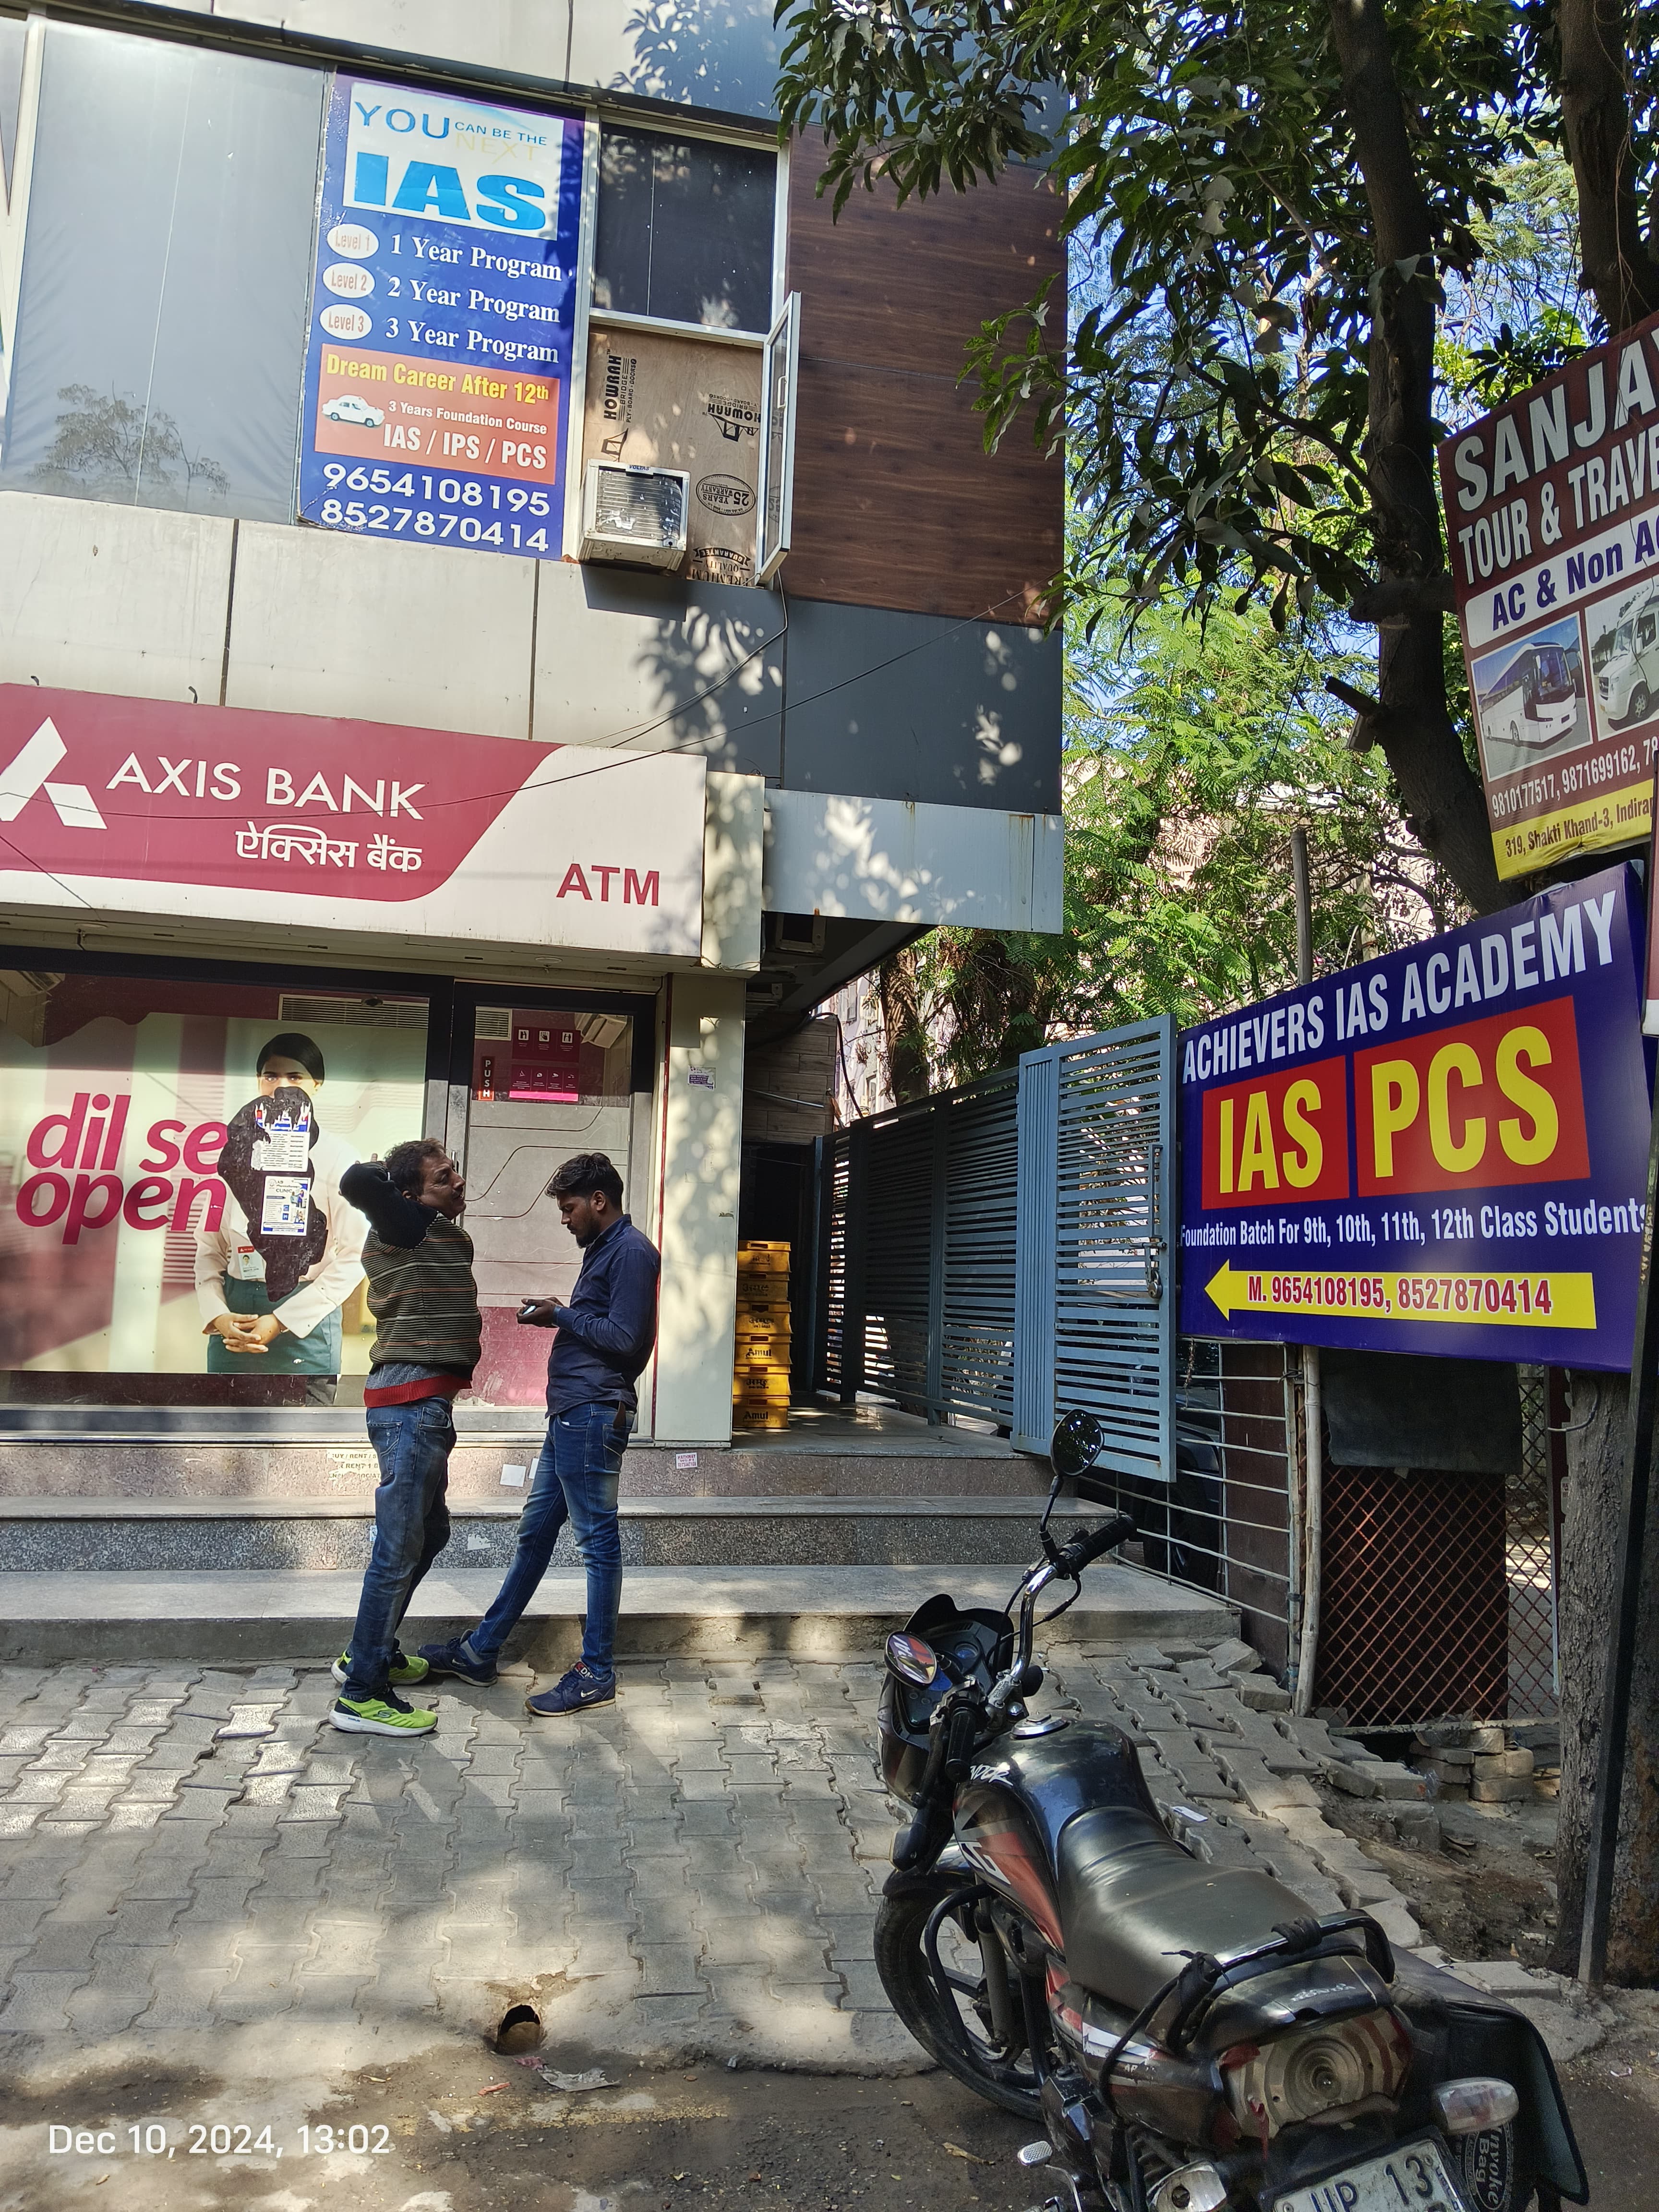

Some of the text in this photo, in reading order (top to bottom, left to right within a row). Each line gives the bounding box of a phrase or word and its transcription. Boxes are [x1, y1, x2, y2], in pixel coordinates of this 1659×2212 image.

[355, 102, 547, 146] YOU CAN BE THE
[354, 152, 546, 230] IAS
[335, 229, 370, 251] Level 1
[391, 234, 562, 281] 1 Year Program
[331, 270, 367, 291] Level 2
[387, 277, 560, 323] 2 Year Program
[328, 312, 364, 331] Level 3
[386, 318, 559, 363] 3 Year Program
[327, 354, 549, 404] Dream Career After 12th
[604, 355, 622, 420] HOWRAH
[388, 401, 547, 435] 3 Years Foundation Course
[708, 403, 761, 423] HOWRAH
[722, 400, 748, 410] BRIDGE
[384, 424, 547, 469] IAS / IPS / PCS
[324, 463, 550, 516] 9654108195
[700, 484, 733, 497] WARRANTY
[702, 491, 750, 506] 25 YEARS
[321, 499, 549, 552] 8527870414
[1458, 498, 1532, 585] TOUR
[1541, 481, 1562, 545] &
[700, 548, 743, 563] GUARANTEE
[704, 560, 739, 573] QUALITY
[1492, 515, 1659, 631] AC & Non A
[106, 752, 425, 820] AXIS BANK
[1492, 773, 1560, 818] 9810177517,
[1562, 745, 1640, 794] 9871699162,
[367, 833, 422, 872] बैंक
[1505, 837, 1526, 858] 319,
[1528, 824, 1561, 850] Shakti
[1563, 807, 1613, 839] Khand-3,
[557, 863, 661, 906] ATM
[1182, 890, 1616, 1083] ACHIEVERS IAS ACADEMY
[483, 1059, 492, 1098] PUSH
[1220, 1025, 1559, 1194] IAS PCS
[27, 1093, 132, 1171] dil
[139, 1120, 228, 1175] se
[16, 1173, 227, 1245] open
[1180, 1222, 1236, 1247] Foundation
[1240, 1219, 1274, 1245] Batch
[1279, 1218, 1299, 1244] For
[1304, 1216, 1331, 1248] 9th,
[1335, 1214, 1376, 1247] 10th,
[1381, 1211, 1425, 1246] 11th,
[1431, 1208, 1474, 1240] 12th
[1480, 1204, 1538, 1238] Class
[1248, 1275, 1552, 1316] M. 9654108195, 8527870414
[745, 1348, 772, 1358] Amul
[744, 1411, 768, 1419] Amul
[1385, 2156, 1433, 2205] 13
[1476, 2138, 1490, 2182] Bag
